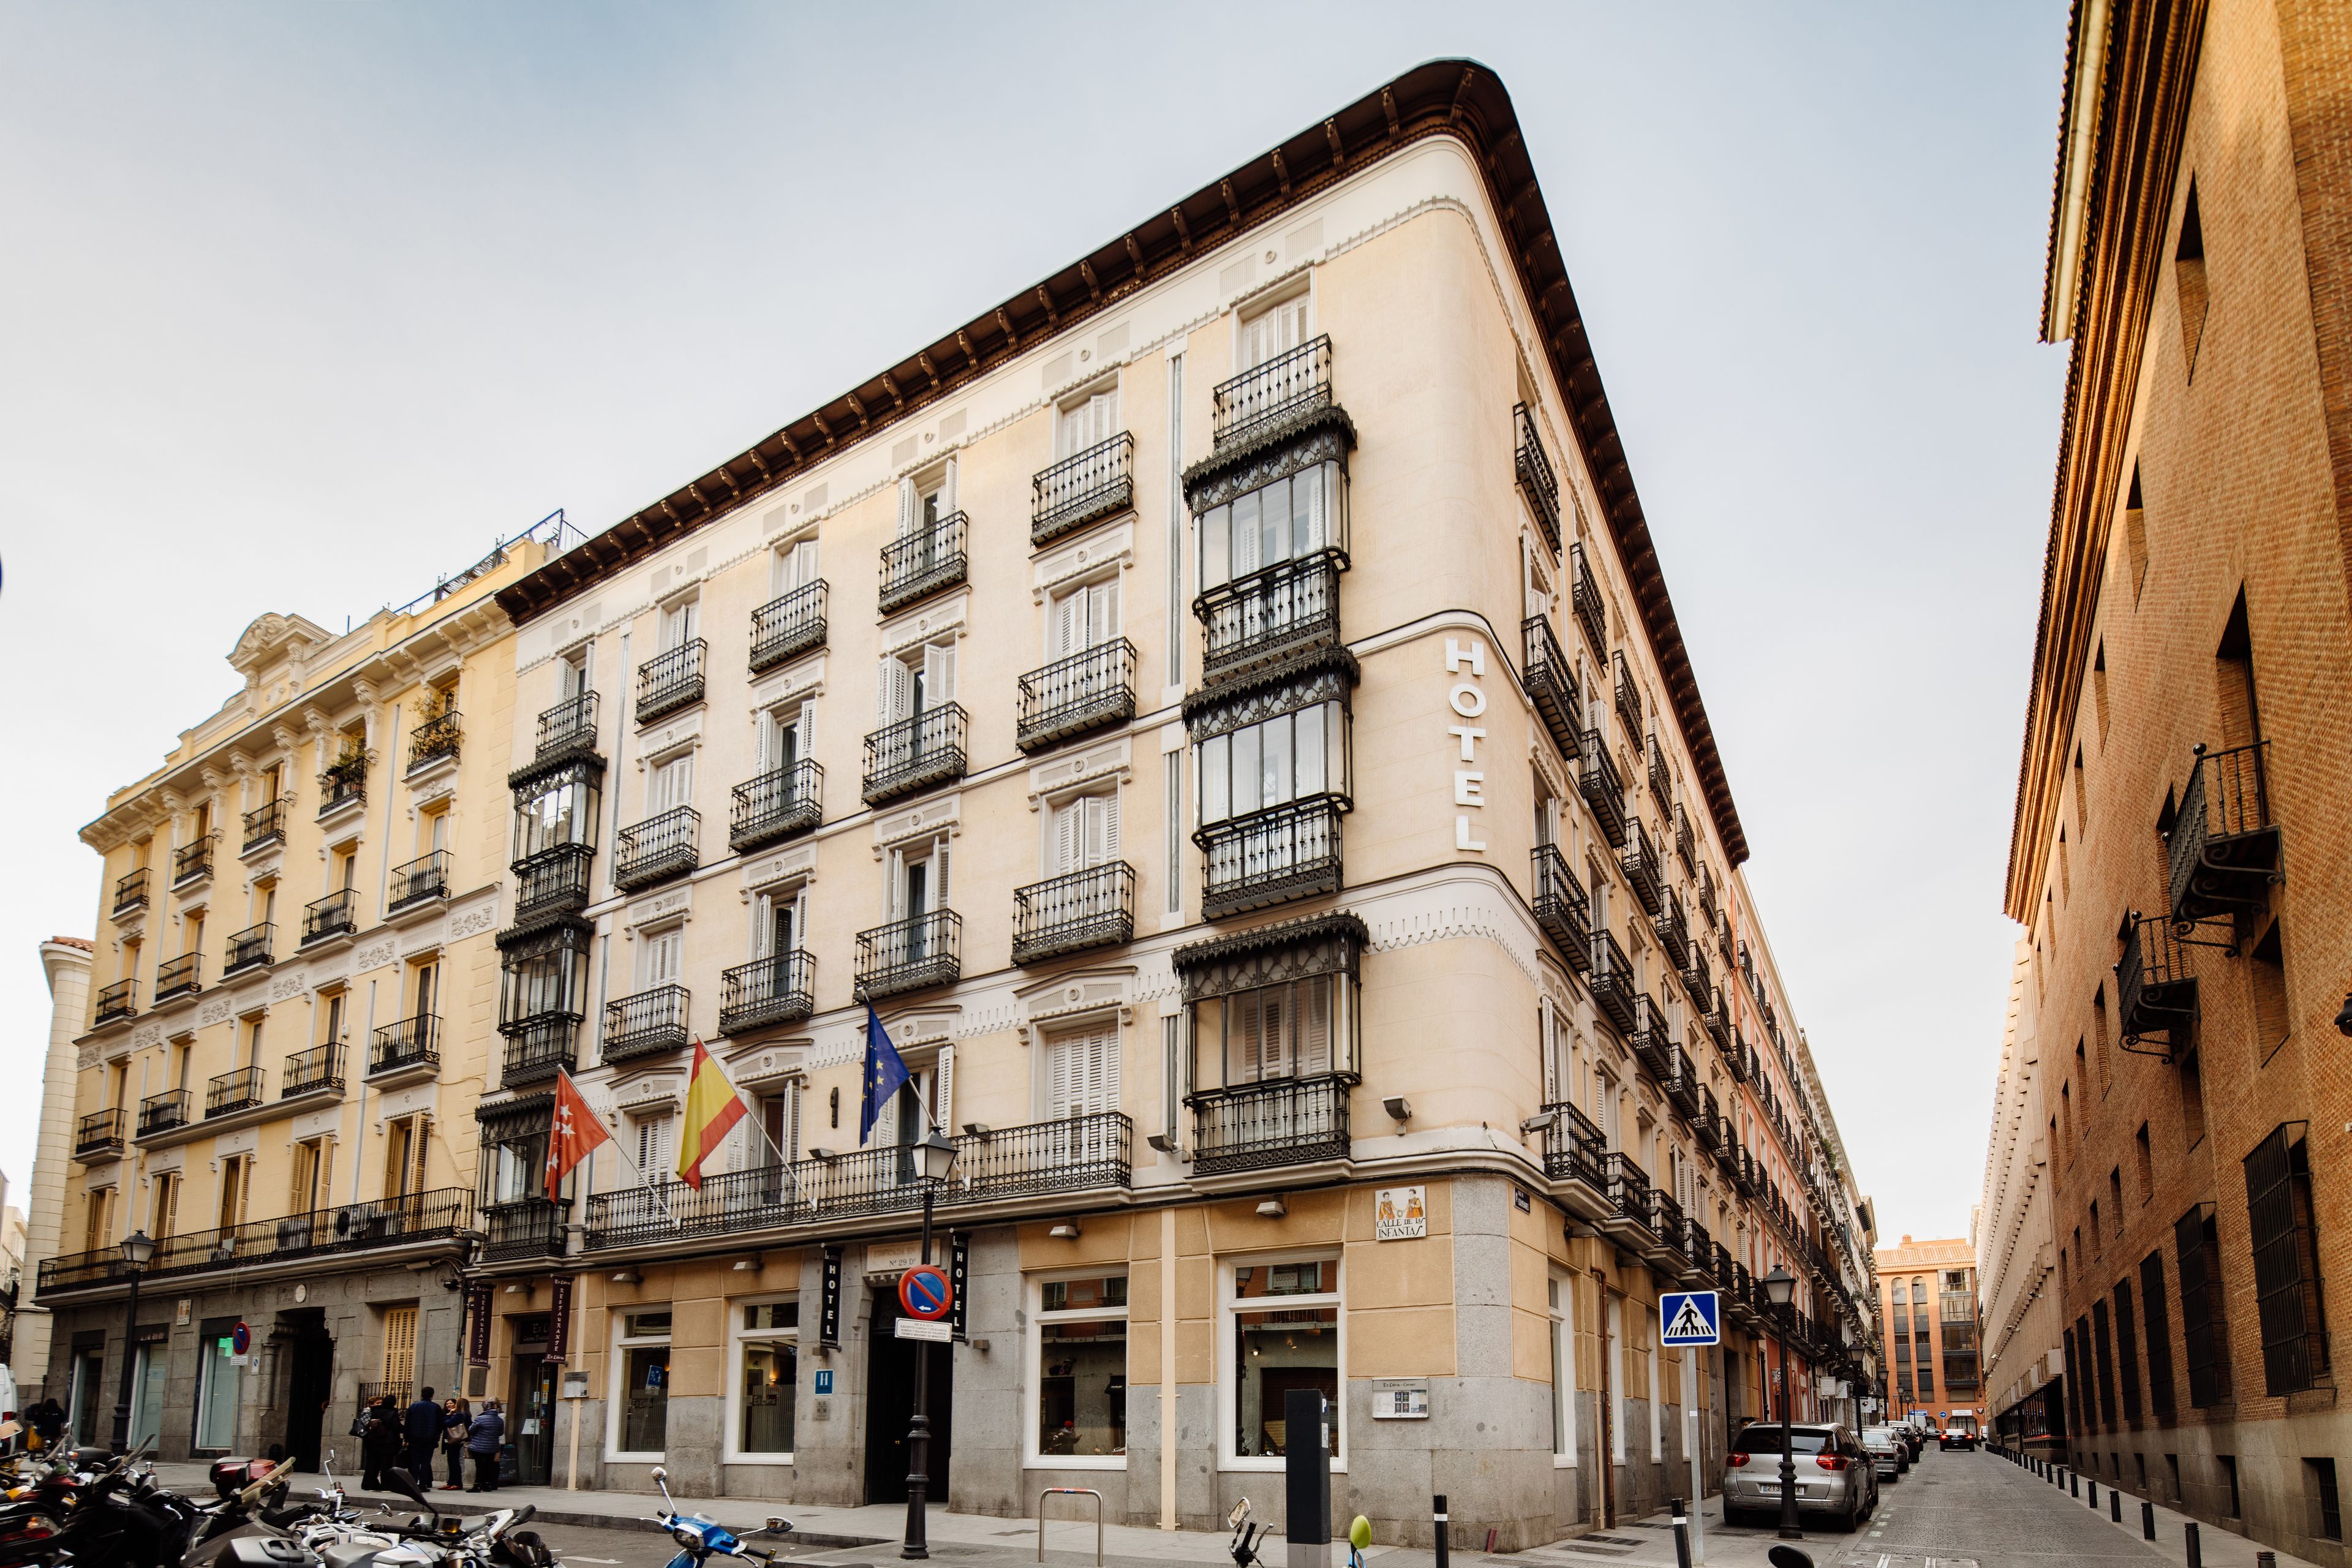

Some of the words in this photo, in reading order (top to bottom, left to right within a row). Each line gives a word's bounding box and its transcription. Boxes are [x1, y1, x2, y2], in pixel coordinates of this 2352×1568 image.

[1446, 638, 1487, 851] HOTEL
[1377, 1219, 1401, 1227] CALLE
[1378, 1225, 1422, 1238] INFANTAS
[554, 1288, 564, 1351] RESTAURANTE
[826, 1265, 835, 1335] HOTEL
[954, 1252, 963, 1327] HOTEL
[478, 1295, 486, 1355] RESTAURANTE
[820, 1373, 828, 1385] H
[1322, 1398, 1327, 1412] P
